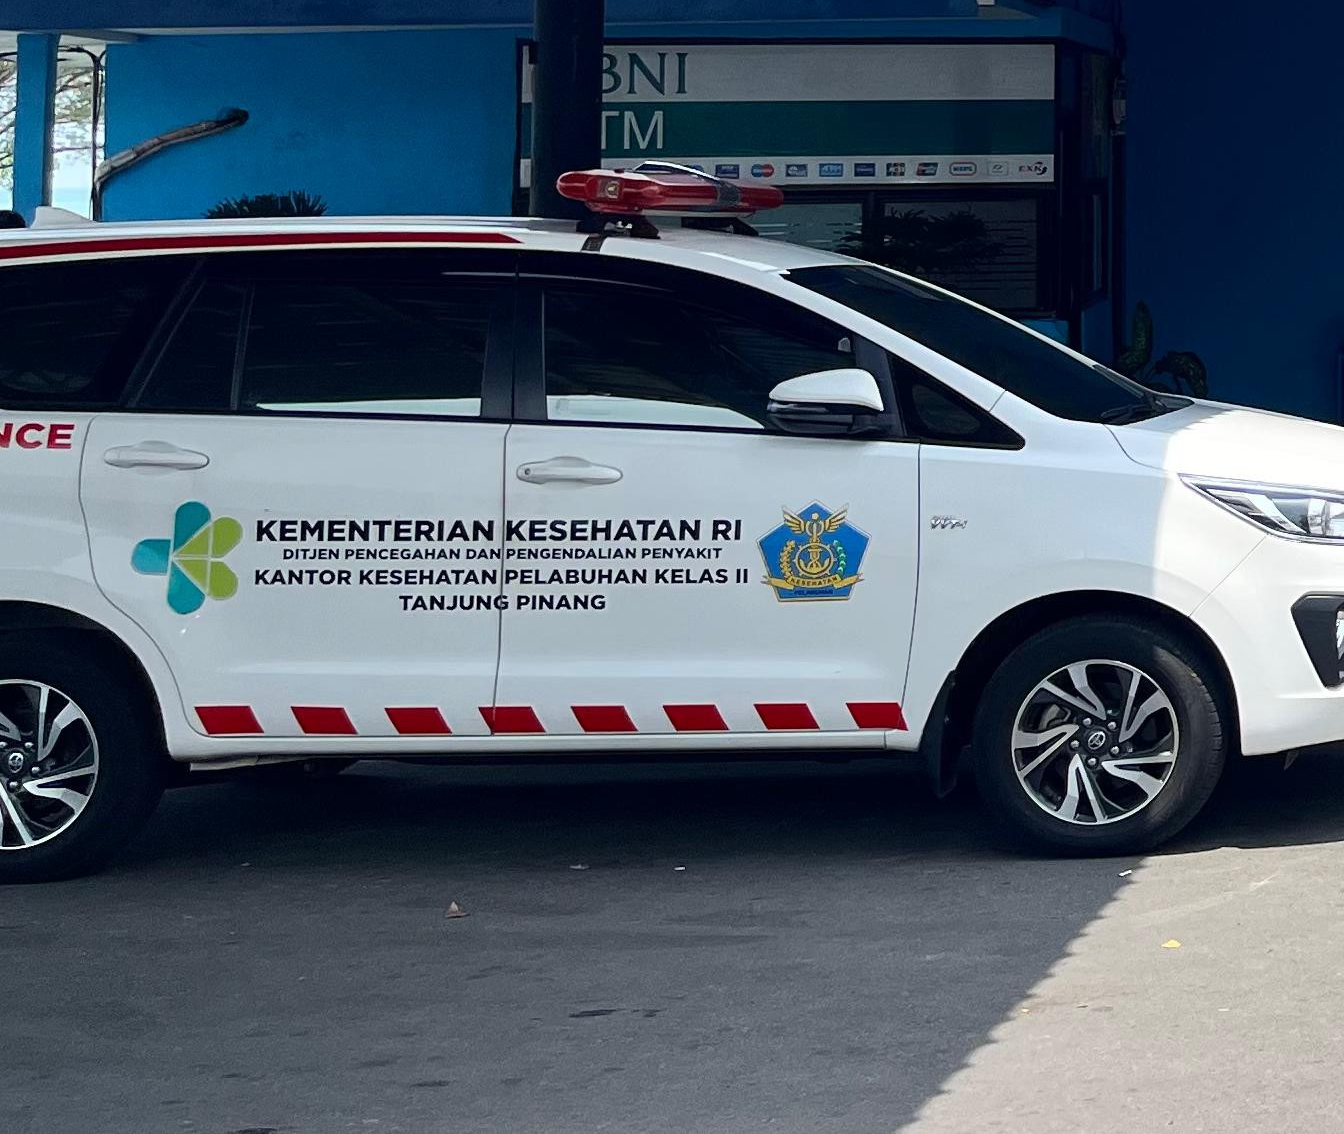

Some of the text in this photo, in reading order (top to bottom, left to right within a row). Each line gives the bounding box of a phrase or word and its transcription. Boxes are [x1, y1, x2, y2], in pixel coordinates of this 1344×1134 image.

[602, 52, 689, 96] BNI
[601, 110, 664, 150] TM
[256, 519, 742, 542] KEMENTERIAN KESEHATAN RI
[283, 547, 723, 560] DITJEN PENCEGAHAN DAN PENGENDALIAN PENYAKIT
[254, 568, 748, 585] KANTOR KESEHATAN PELABUHAN KELAS II
[790, 575, 838, 587] KESEHATAN
[399, 595, 606, 611] TANJUNG PINANG
